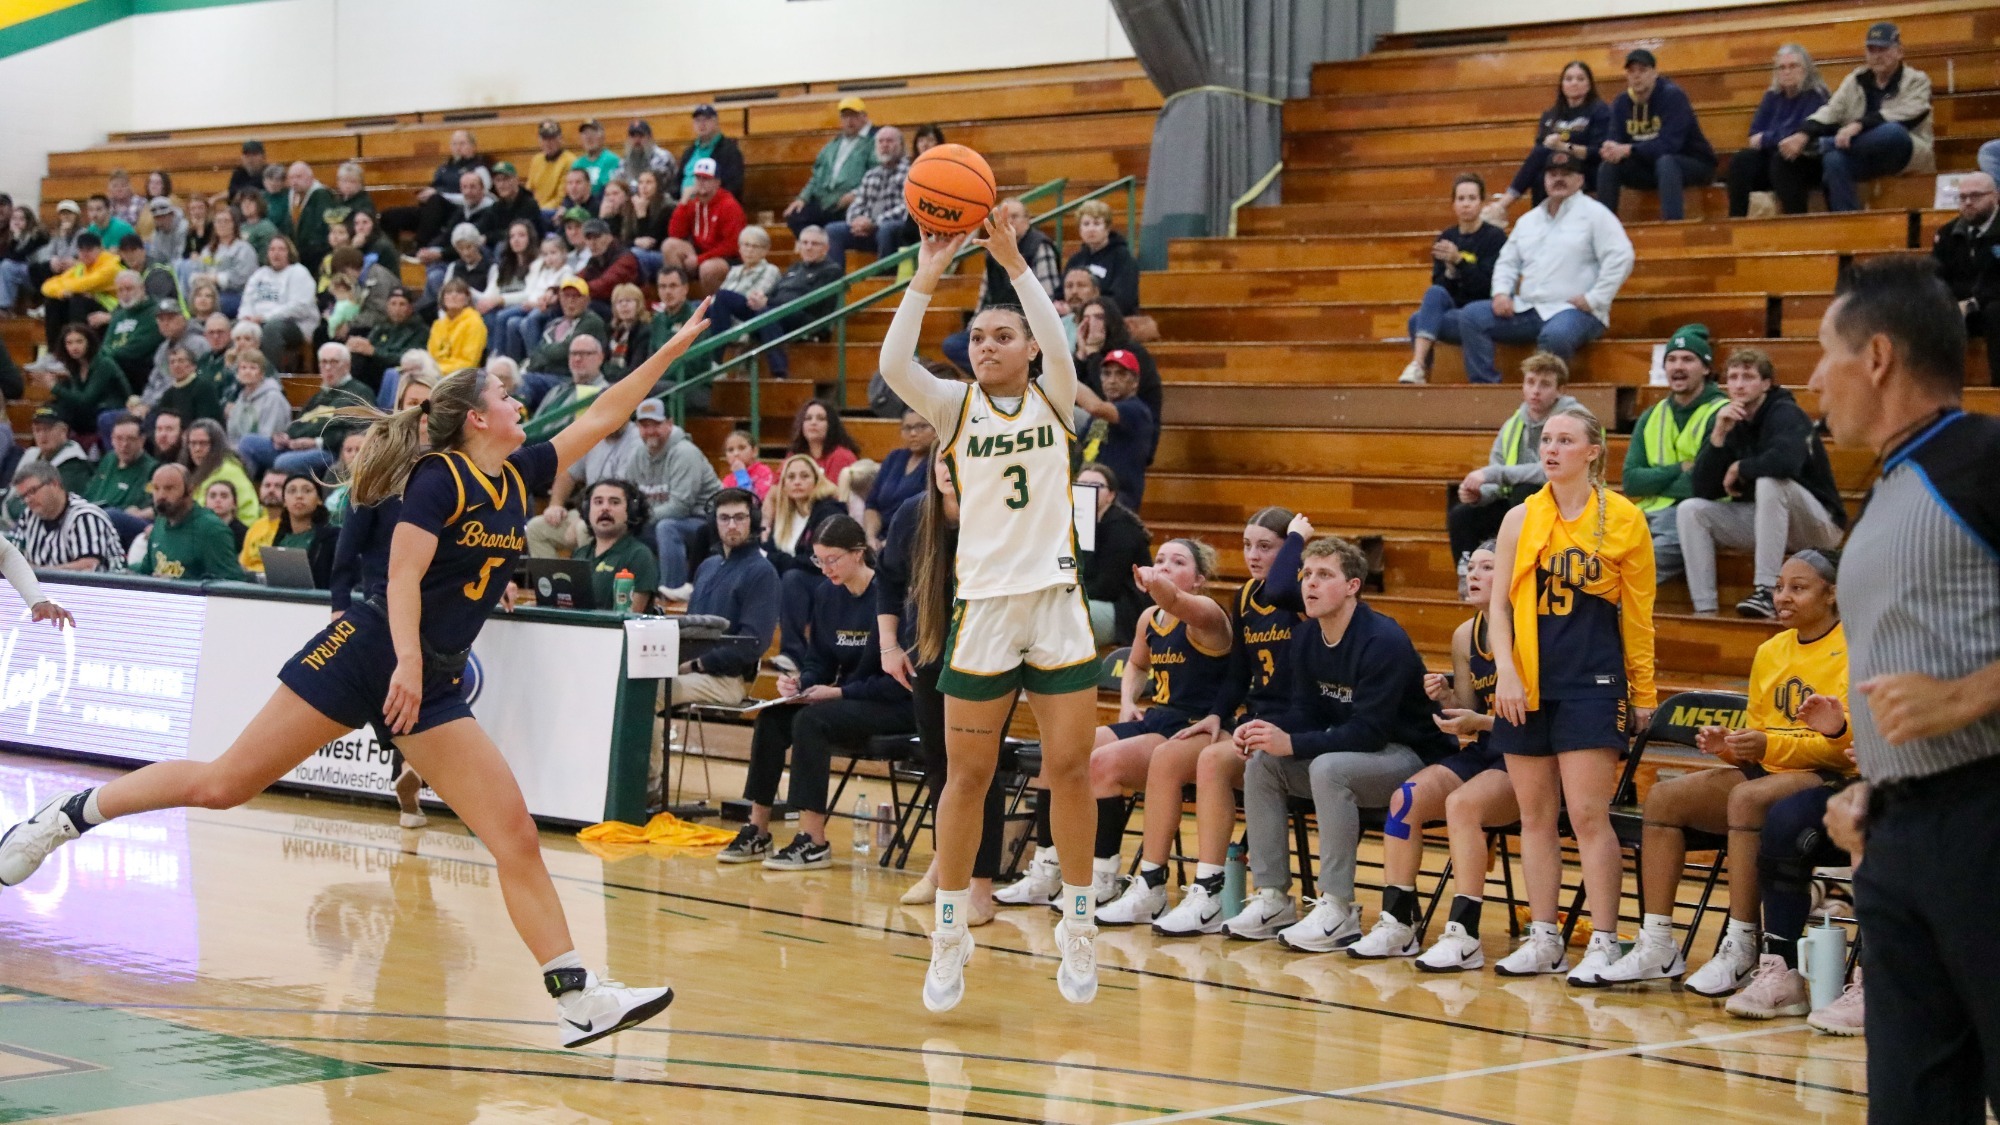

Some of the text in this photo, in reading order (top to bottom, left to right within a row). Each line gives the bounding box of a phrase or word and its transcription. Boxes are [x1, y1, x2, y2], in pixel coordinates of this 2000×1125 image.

[918, 197, 963, 222] NCAA
[966, 424, 1054, 458] MSSU
[1001, 463, 1030, 511] 3
[463, 557, 506, 601] 5
[1549, 547, 1602, 589] UCO
[1537, 574, 1574, 616] 15
[301, 620, 356, 672] CENTRAL
[1150, 646, 1186, 665] onchos
[1258, 649, 1275, 686] 3
[366, 738, 394, 766] Fo
